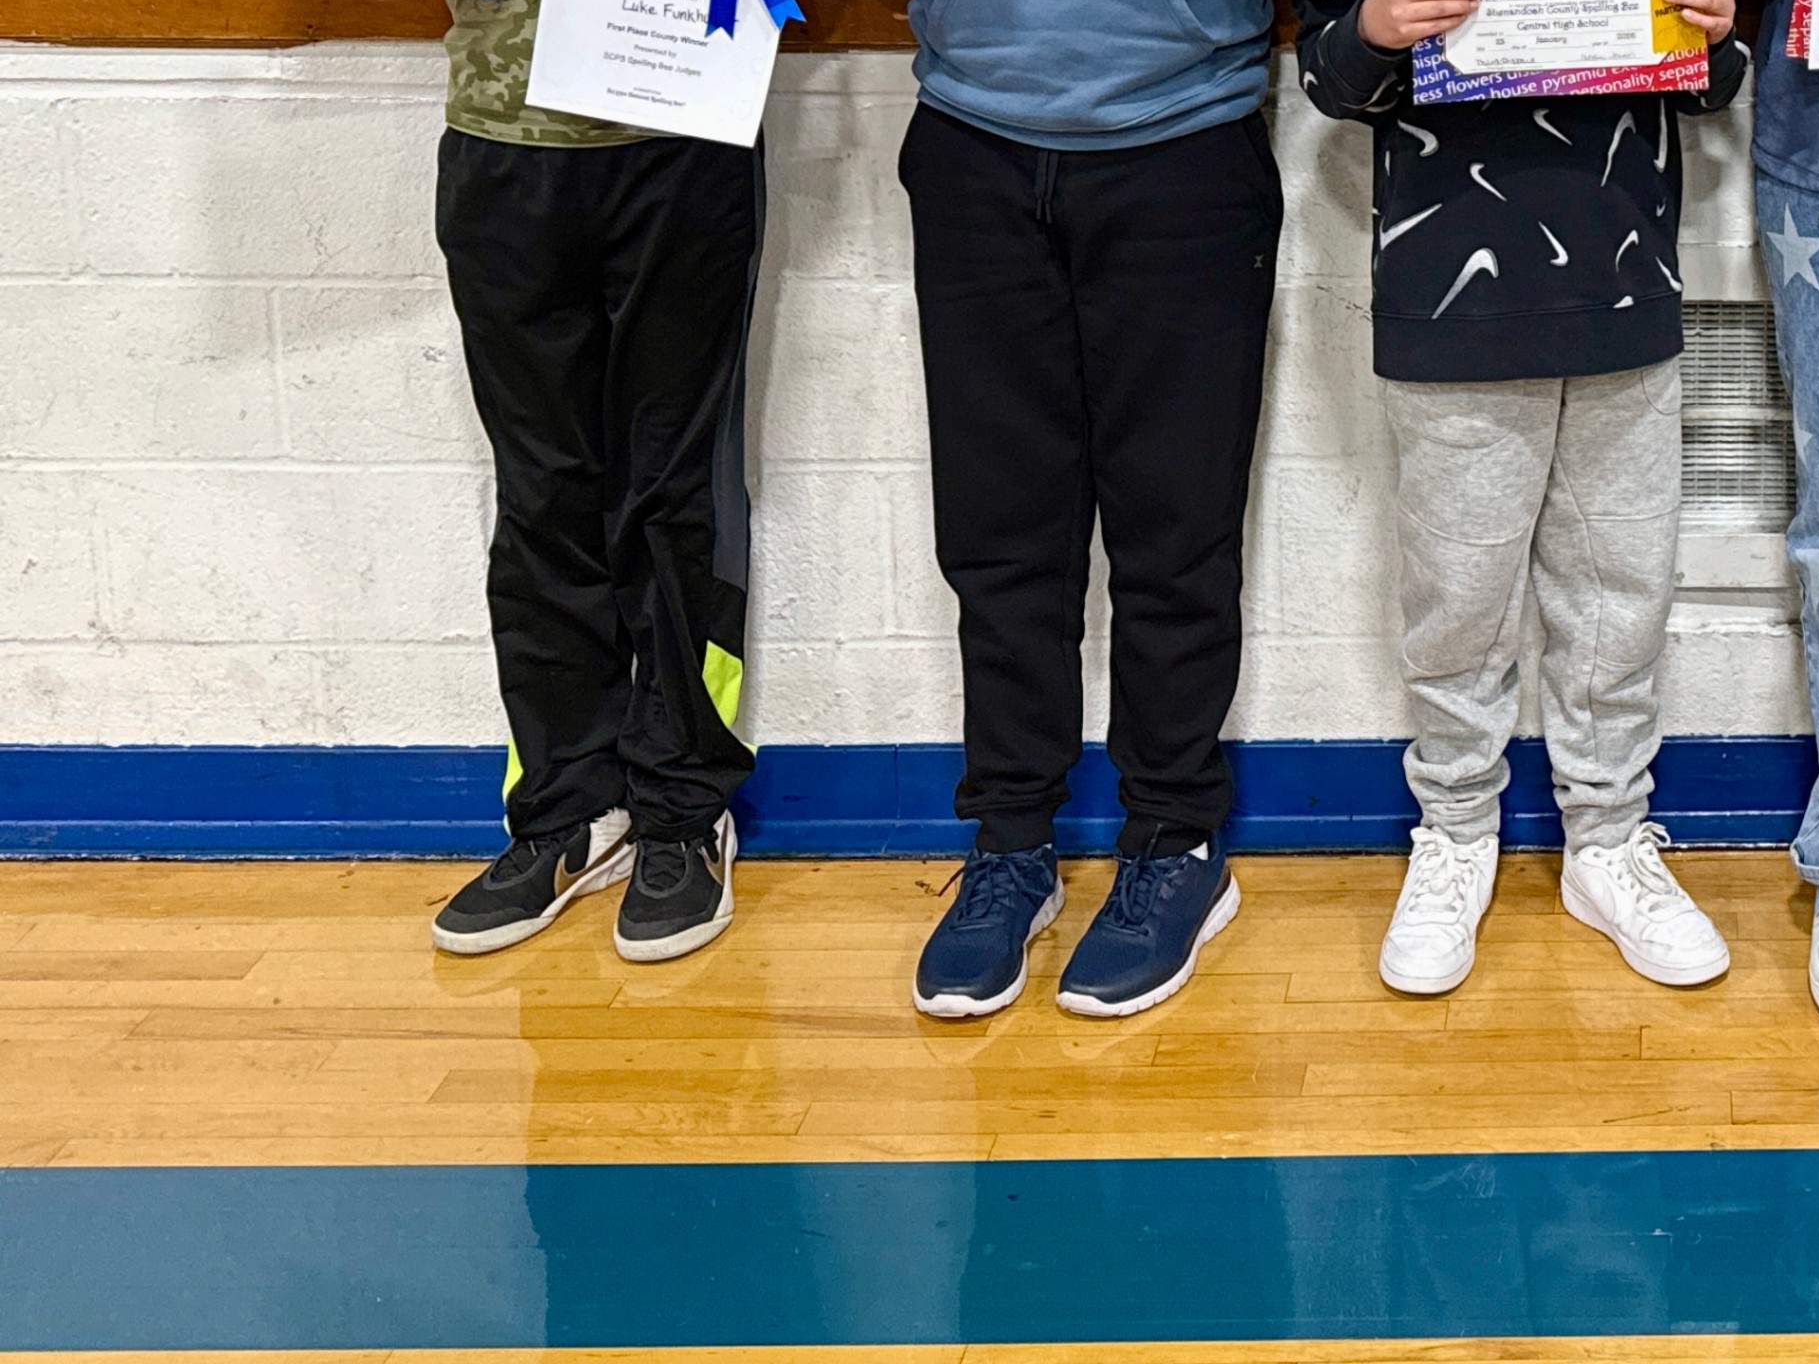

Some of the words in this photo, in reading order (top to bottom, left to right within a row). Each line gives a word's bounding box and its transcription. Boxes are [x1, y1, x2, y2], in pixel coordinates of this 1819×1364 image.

[1517, 20, 1551, 31] Central
[1577, 18, 1609, 28] School
[1446, 73, 1503, 95] flowers
[1490, 81, 1538, 99] house
[1570, 73, 1655, 95] personality
